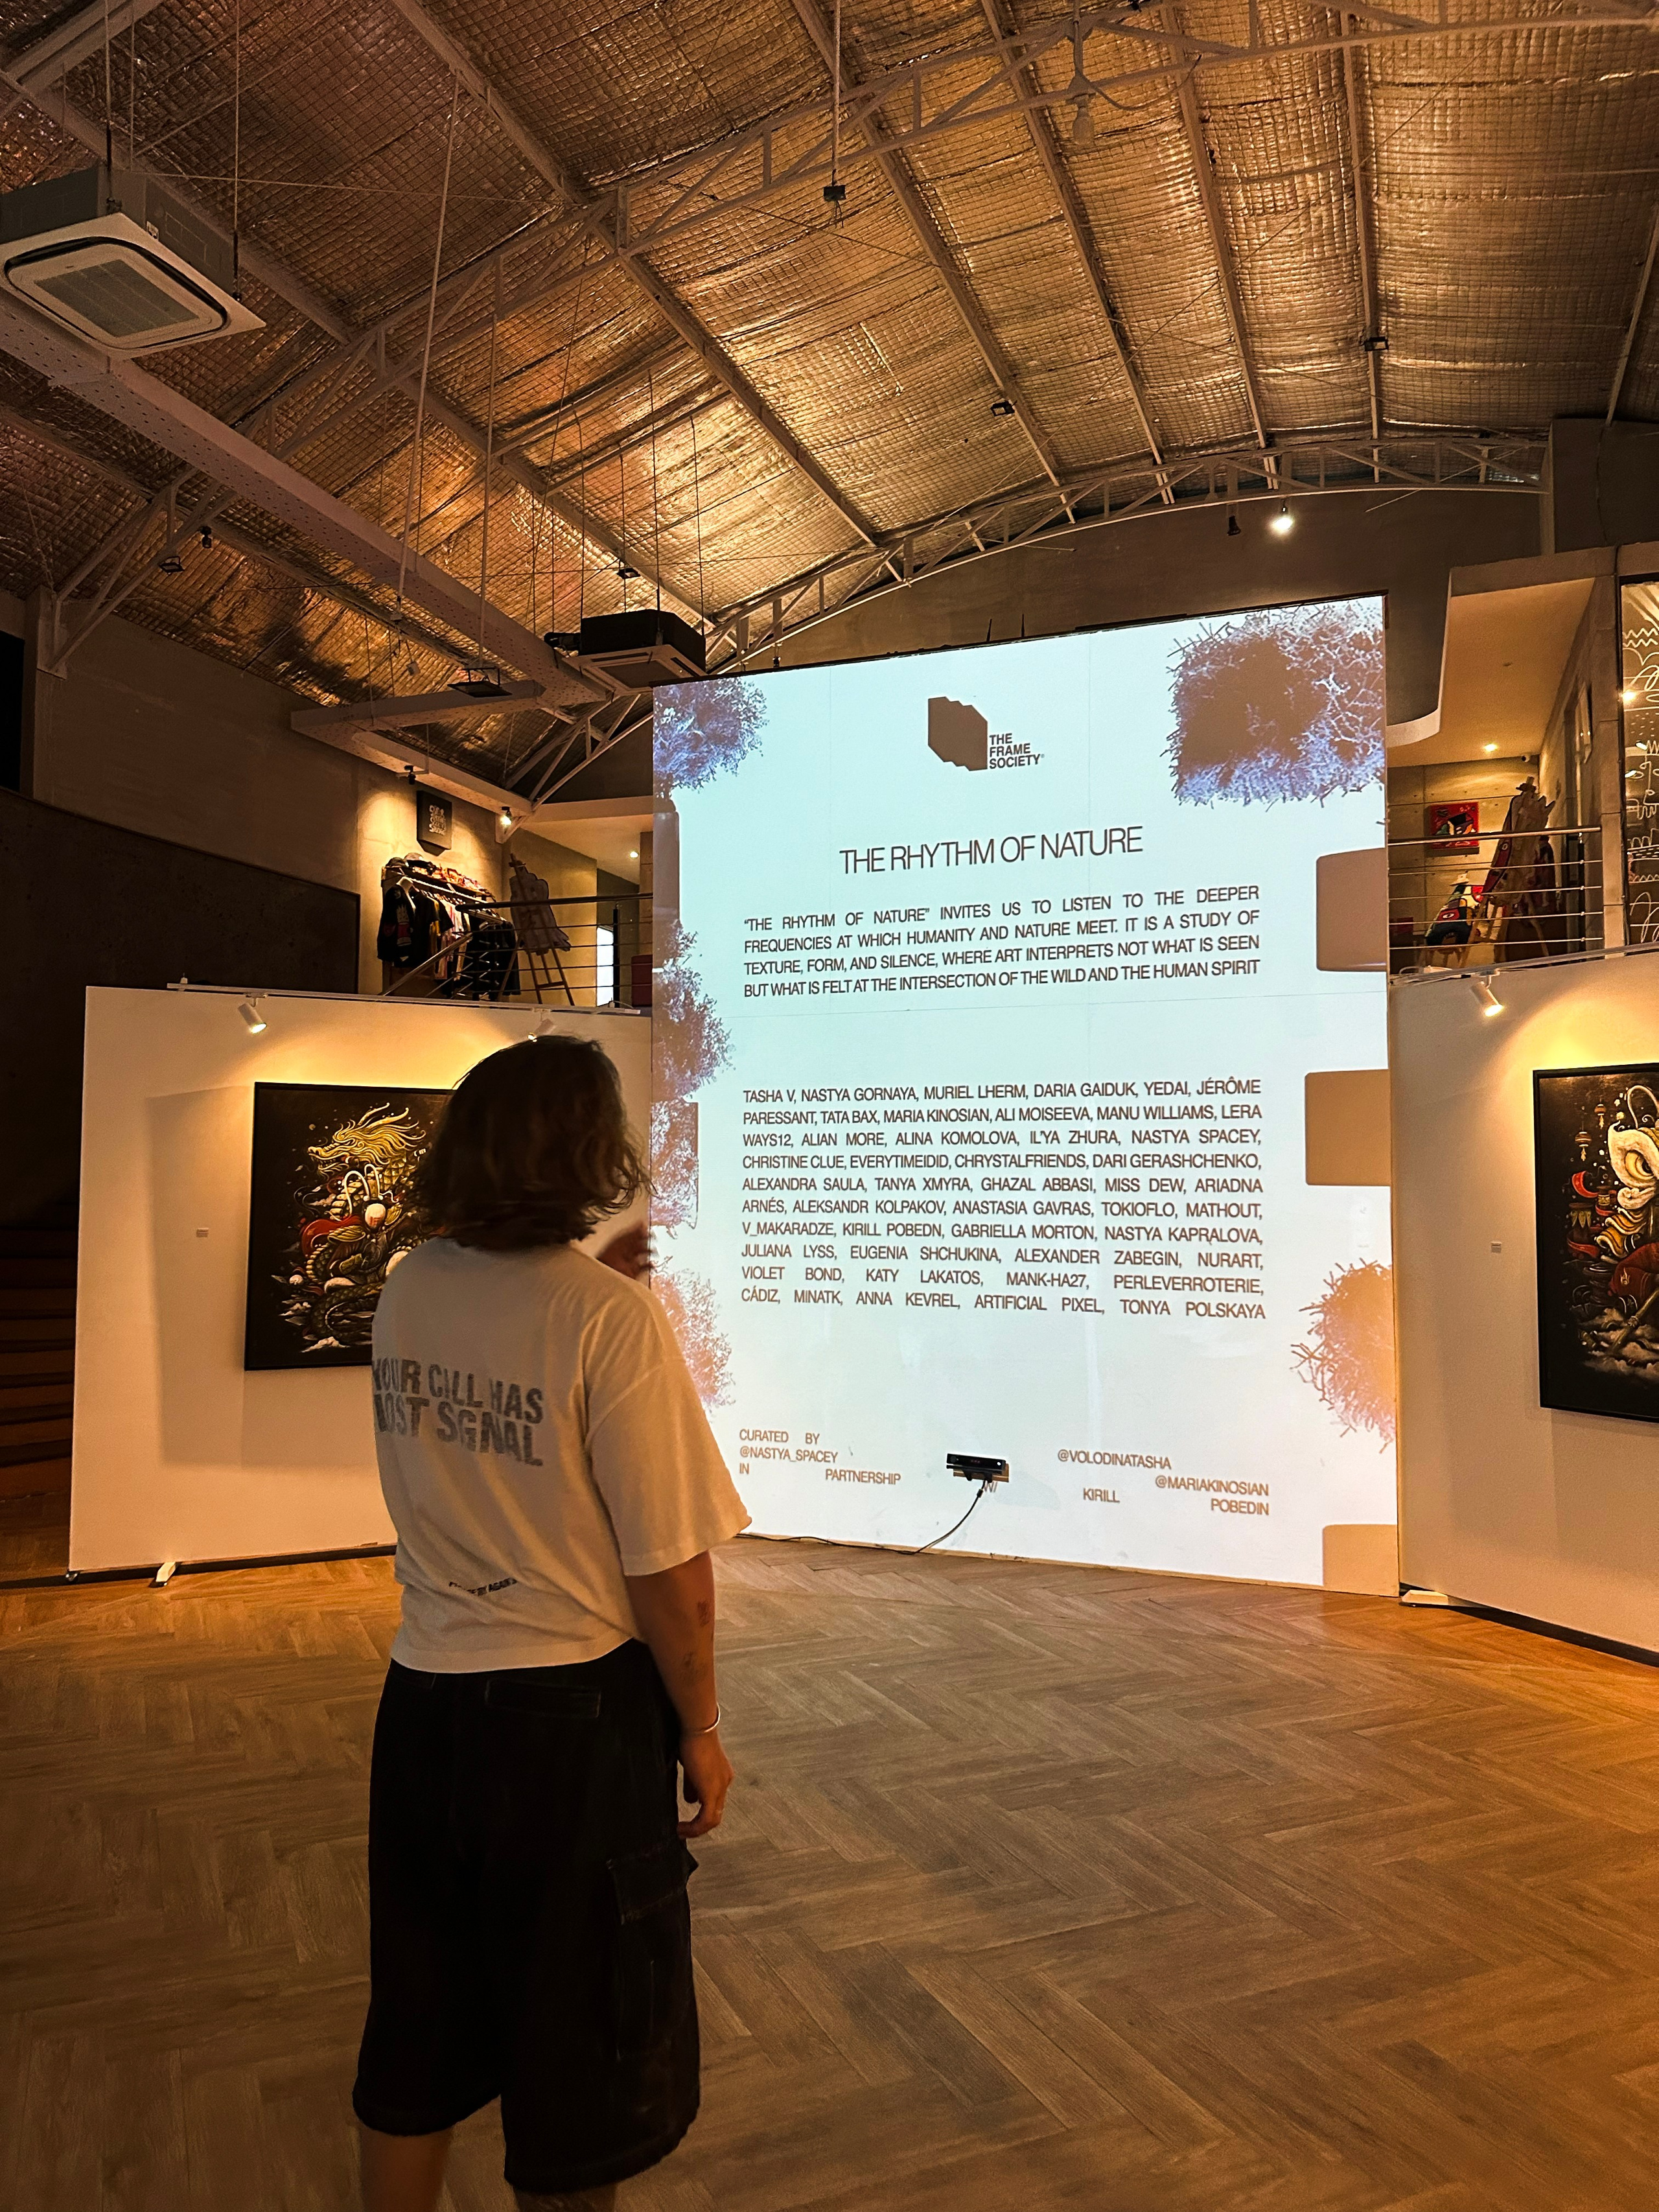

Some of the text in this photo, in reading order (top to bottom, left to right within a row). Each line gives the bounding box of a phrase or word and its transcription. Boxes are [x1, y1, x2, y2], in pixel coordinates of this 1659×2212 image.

[989, 733, 1013, 745] THE
[989, 743, 1031, 757] FRAME
[839, 826, 1143, 874] THE RHYTHM OF NATURE
[783, 914, 835, 929] RHYTHM
[846, 911, 863, 926] OF
[941, 903, 990, 920] INVITES
[1003, 902, 1021, 916] US
[1032, 900, 1051, 914] TO
[1063, 896, 1111, 913] LISTEN
[1122, 893, 1143, 908] TO
[1154, 890, 1184, 905] THE
[1197, 885, 1259, 903] DEEPER
[745, 909, 1260, 953] FREQUENCIES AT WHICH HUMANITY AND NATURE MEET. IT IS A STUDY OF
[744, 935, 1259, 975] TEXTURE, FORM, AND SILENCE, WHERE ART INTERPRETS NOT WHAT IS SEEN
[745, 959, 1260, 997] BUT WHAT IS FELT AT THE INTERSECTION OF THE WILD AND THE HUMAN SPIRIT
[743, 1076, 1261, 1104] TASHA V, NASTYA GORNAYA, MURIEL LHERM, DARIA GAIDUK, YEDAI, JÉRÔME
[744, 1104, 1262, 1126] PARESSANT, TATA BAX, MARIA KINOSIAN, ALI MOISEEVA, MANU WILLIAMS, LERA
[743, 1133, 793, 1148] WAYS12,
[802, 1132, 837, 1147] ALIAN
[846, 1132, 887, 1148] MORE,
[896, 1132, 933, 1145] ALINA
[942, 1131, 1019, 1147] KOMOLOVA,
[1069, 1130, 1120, 1147] ZHURA,
[1132, 1129, 1190, 1144] NASTYA
[1199, 1128, 1260, 1145] SPACEY,
[743, 1153, 1261, 1170] CHRISTINE CLUE, EVERYTIMEIDID, CHRYSTALFRIENDS, DARI GERASHCHENKO,
[743, 1177, 1263, 1195] ALEXANDRA SAULA, TANYA XMYRA, GHAZAL ABBASI, MISS DEW, ARIADNA
[742, 1196, 1262, 1220] ARNÉS, ALEKSANDR KOLPAKOV, ANASTASIA GAVRAS, TOKIOFLO, MATHOUT,
[843, 1222, 881, 1237] KIRILL
[951, 1223, 1027, 1239] GABRIELLA
[1032, 1224, 1097, 1242] MORTON,
[1105, 1226, 1163, 1241] NASTYA
[741, 1244, 1263, 1270] JULIANA LYSS, EUGENIA SHCHUKINA, ALEXANDER ZABEGIN, NURART,
[742, 1266, 1264, 1296] VIOLET BOND, KATY LAKATOS, MANK-HA27, PERLEVERROTERIE,
[741, 1285, 1266, 1320] CÁDIZ, MINATK, ANNA KEVREL, ARTIFICIAL PIXEL, TONYA POLSKAYA
[489, 1377, 544, 1424] HAS
[739, 1428, 820, 1445] CURATED BY
[740, 1446, 838, 1463] @NASTYA_SPACEY
[1058, 1449, 1172, 1471] @VOLODINATASHA
[739, 1463, 750, 1476] IN
[826, 1469, 901, 1485] PARTNERSHIP
[1084, 1487, 1120, 1504] KIRILL
[1211, 1498, 1269, 1516] POBEDIN
[1155, 1474, 1269, 1496] @MARIAKINOSIAN
